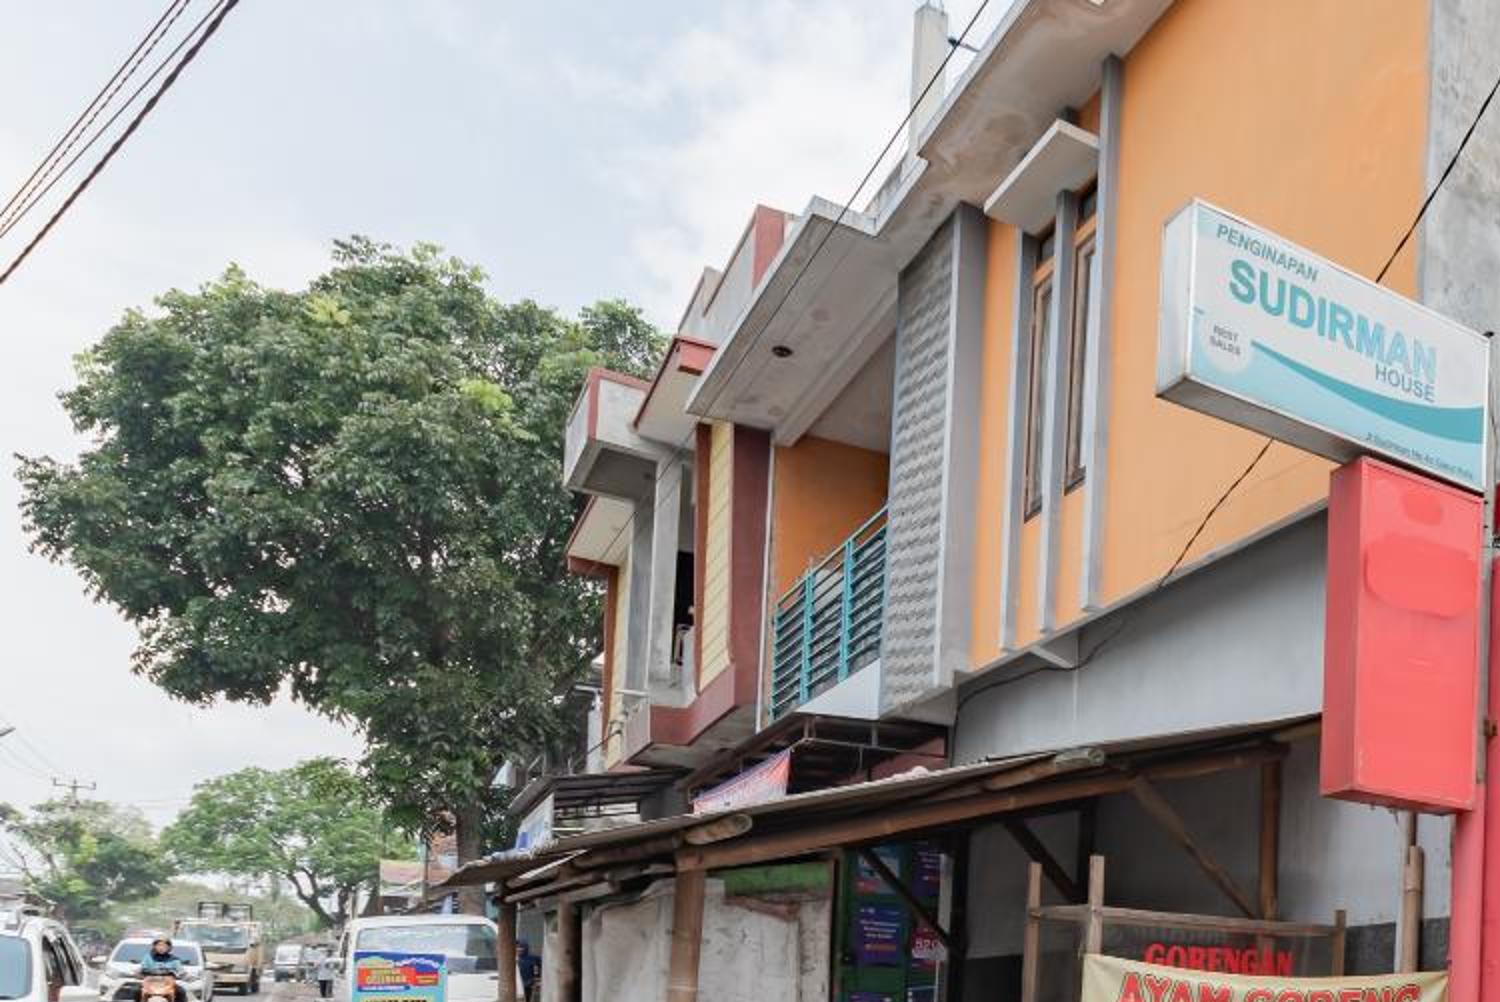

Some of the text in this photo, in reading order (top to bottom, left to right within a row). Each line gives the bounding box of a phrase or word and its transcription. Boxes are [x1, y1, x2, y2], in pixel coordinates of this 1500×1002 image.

[1216, 223, 1318, 282] PENGINAPAN
[1229, 259, 1438, 385] SUDIRMAN
[1375, 363, 1435, 403] HOUSE
[1144, 942, 1293, 976] GORENGAN
